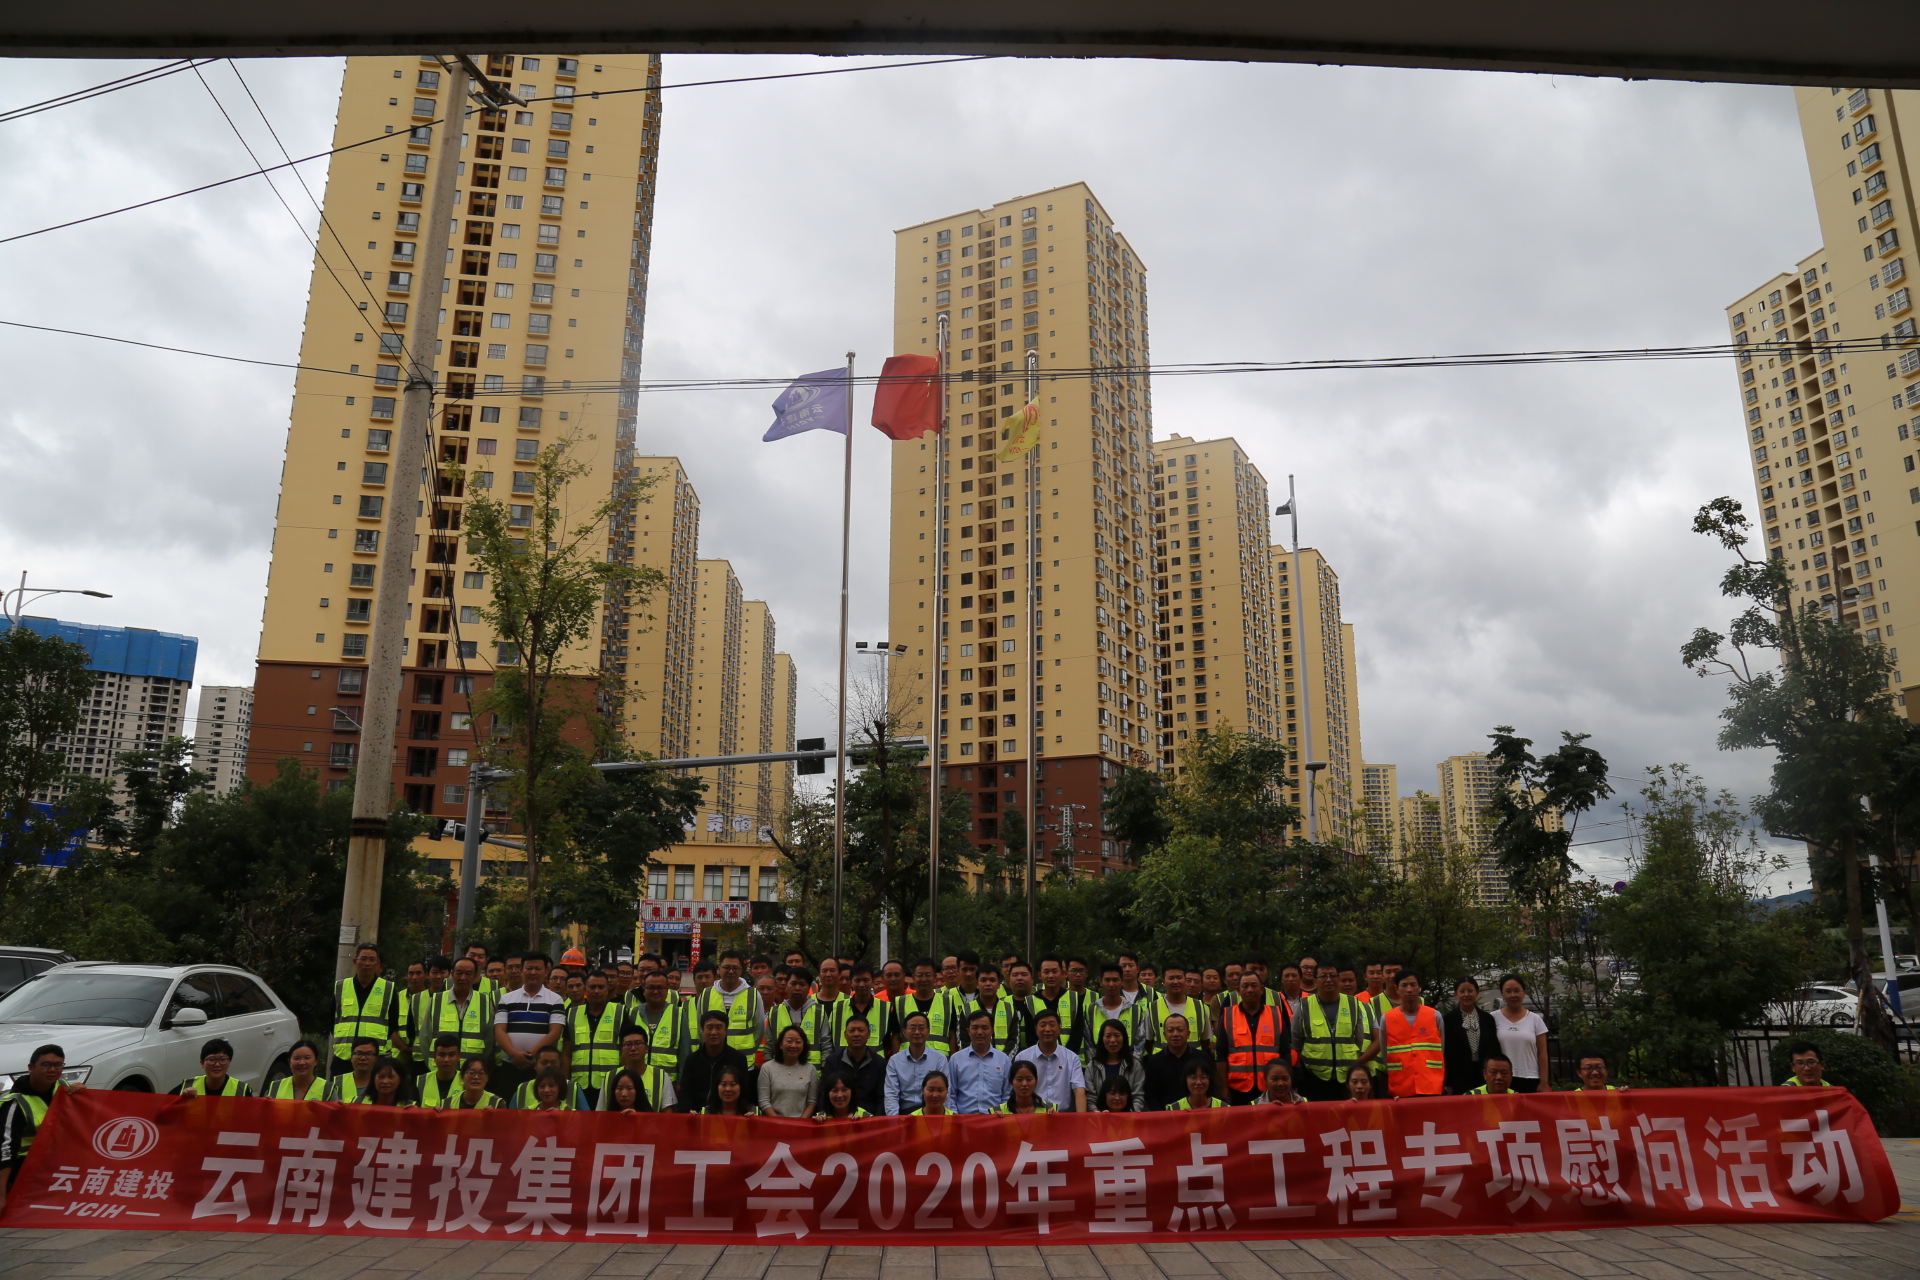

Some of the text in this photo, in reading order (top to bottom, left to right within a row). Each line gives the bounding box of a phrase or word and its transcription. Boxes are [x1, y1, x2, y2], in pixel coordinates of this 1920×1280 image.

[652, 907, 739, 918] 老苗医养生堂
[48, 1165, 175, 1200] 云南建投
[191, 1109, 1865, 1240] 云南建投集团工会2020年重点工程专项慰问活动
[64, 1202, 127, 1219] YCIH
